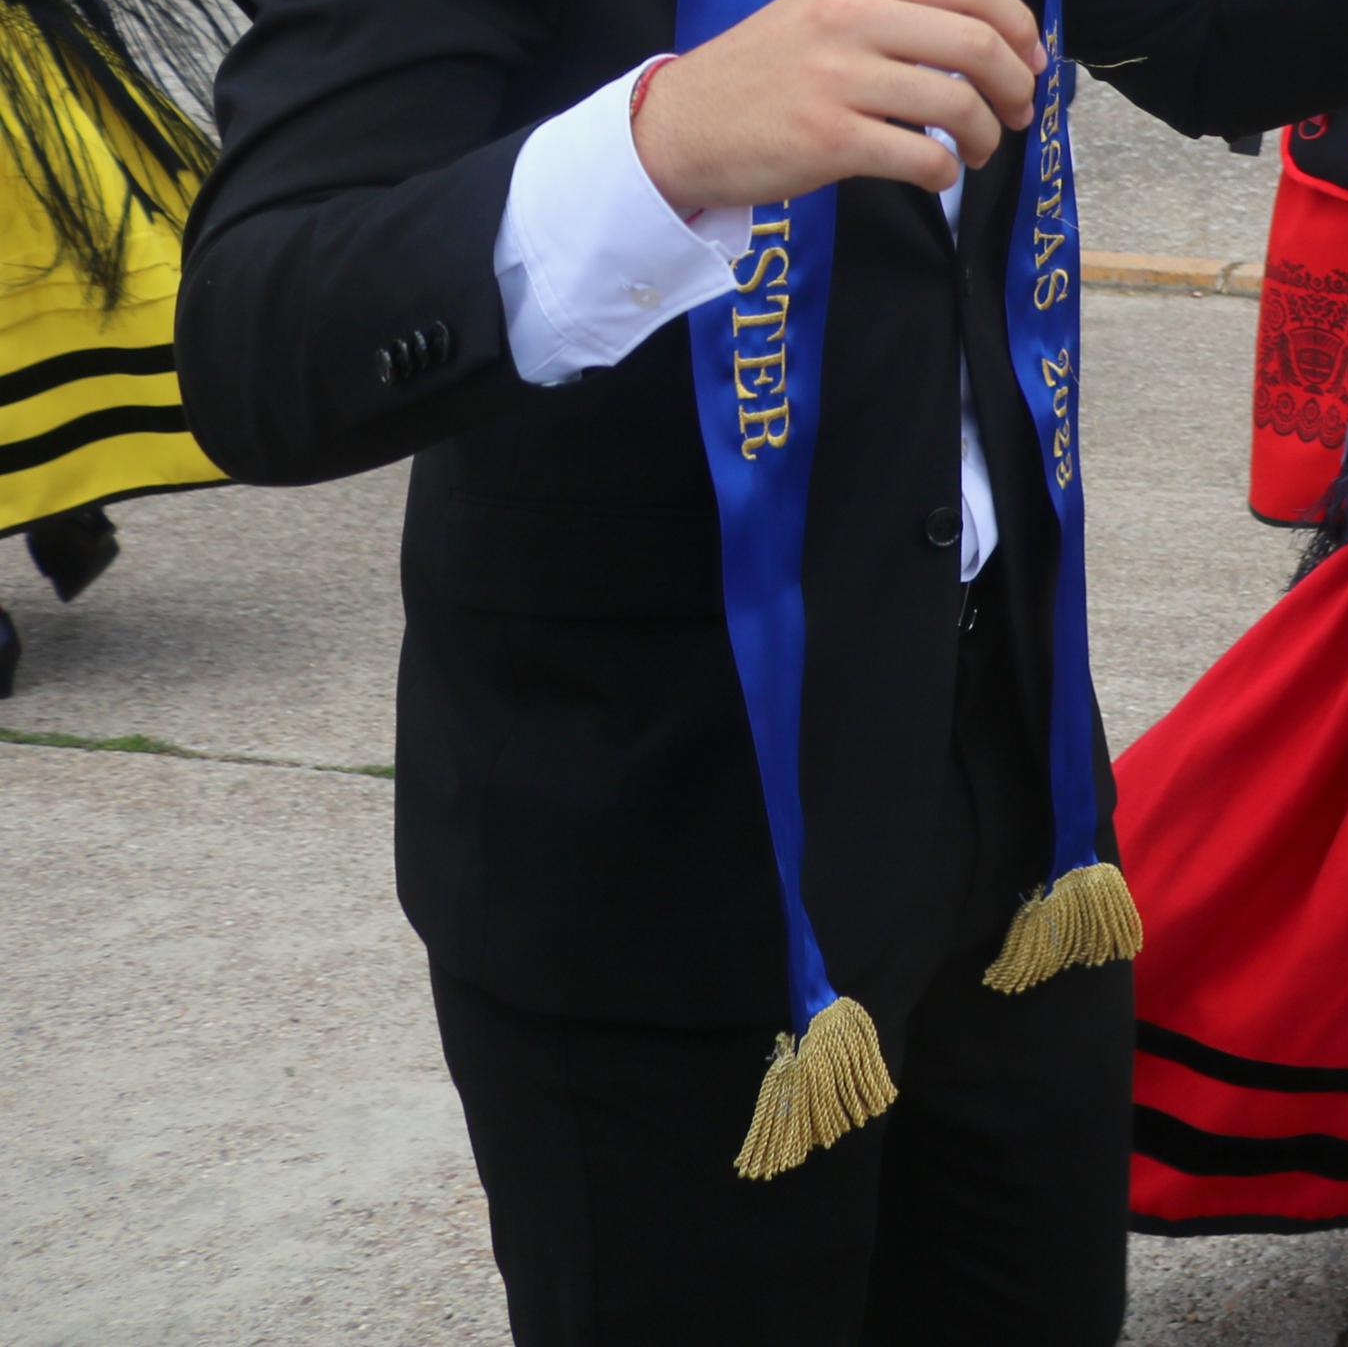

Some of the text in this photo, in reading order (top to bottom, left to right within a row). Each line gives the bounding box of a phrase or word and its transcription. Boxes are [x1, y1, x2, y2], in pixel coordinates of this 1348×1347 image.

[731, 198, 791, 461] ISTER
[1033, 19, 1074, 491] FIESTAS 2023
